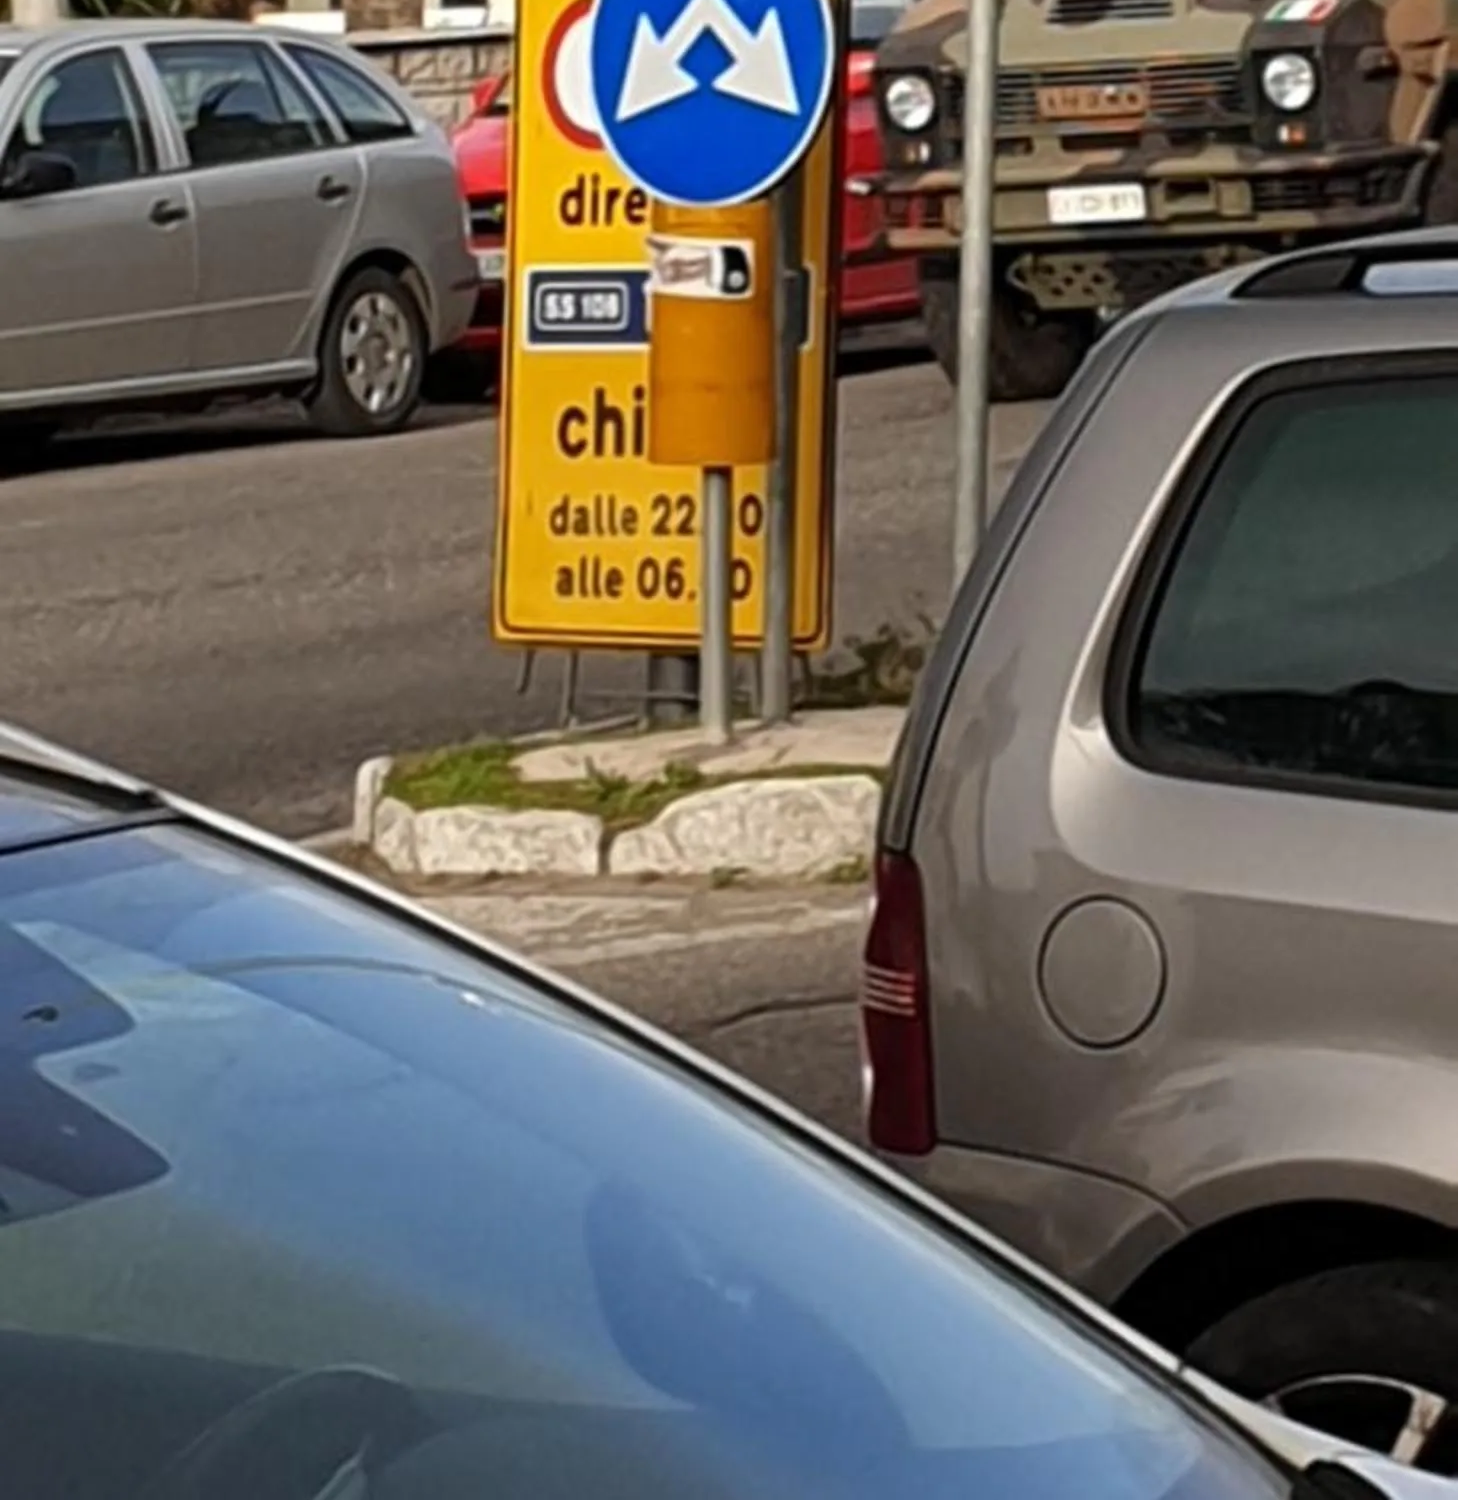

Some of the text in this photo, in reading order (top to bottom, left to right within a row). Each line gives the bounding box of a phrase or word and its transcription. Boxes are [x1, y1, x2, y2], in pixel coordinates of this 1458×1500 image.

[560, 174, 646, 226] dire
[557, 386, 645, 458] chi
[550, 494, 639, 536] dalle
[556, 554, 753, 601] alle 06.0
